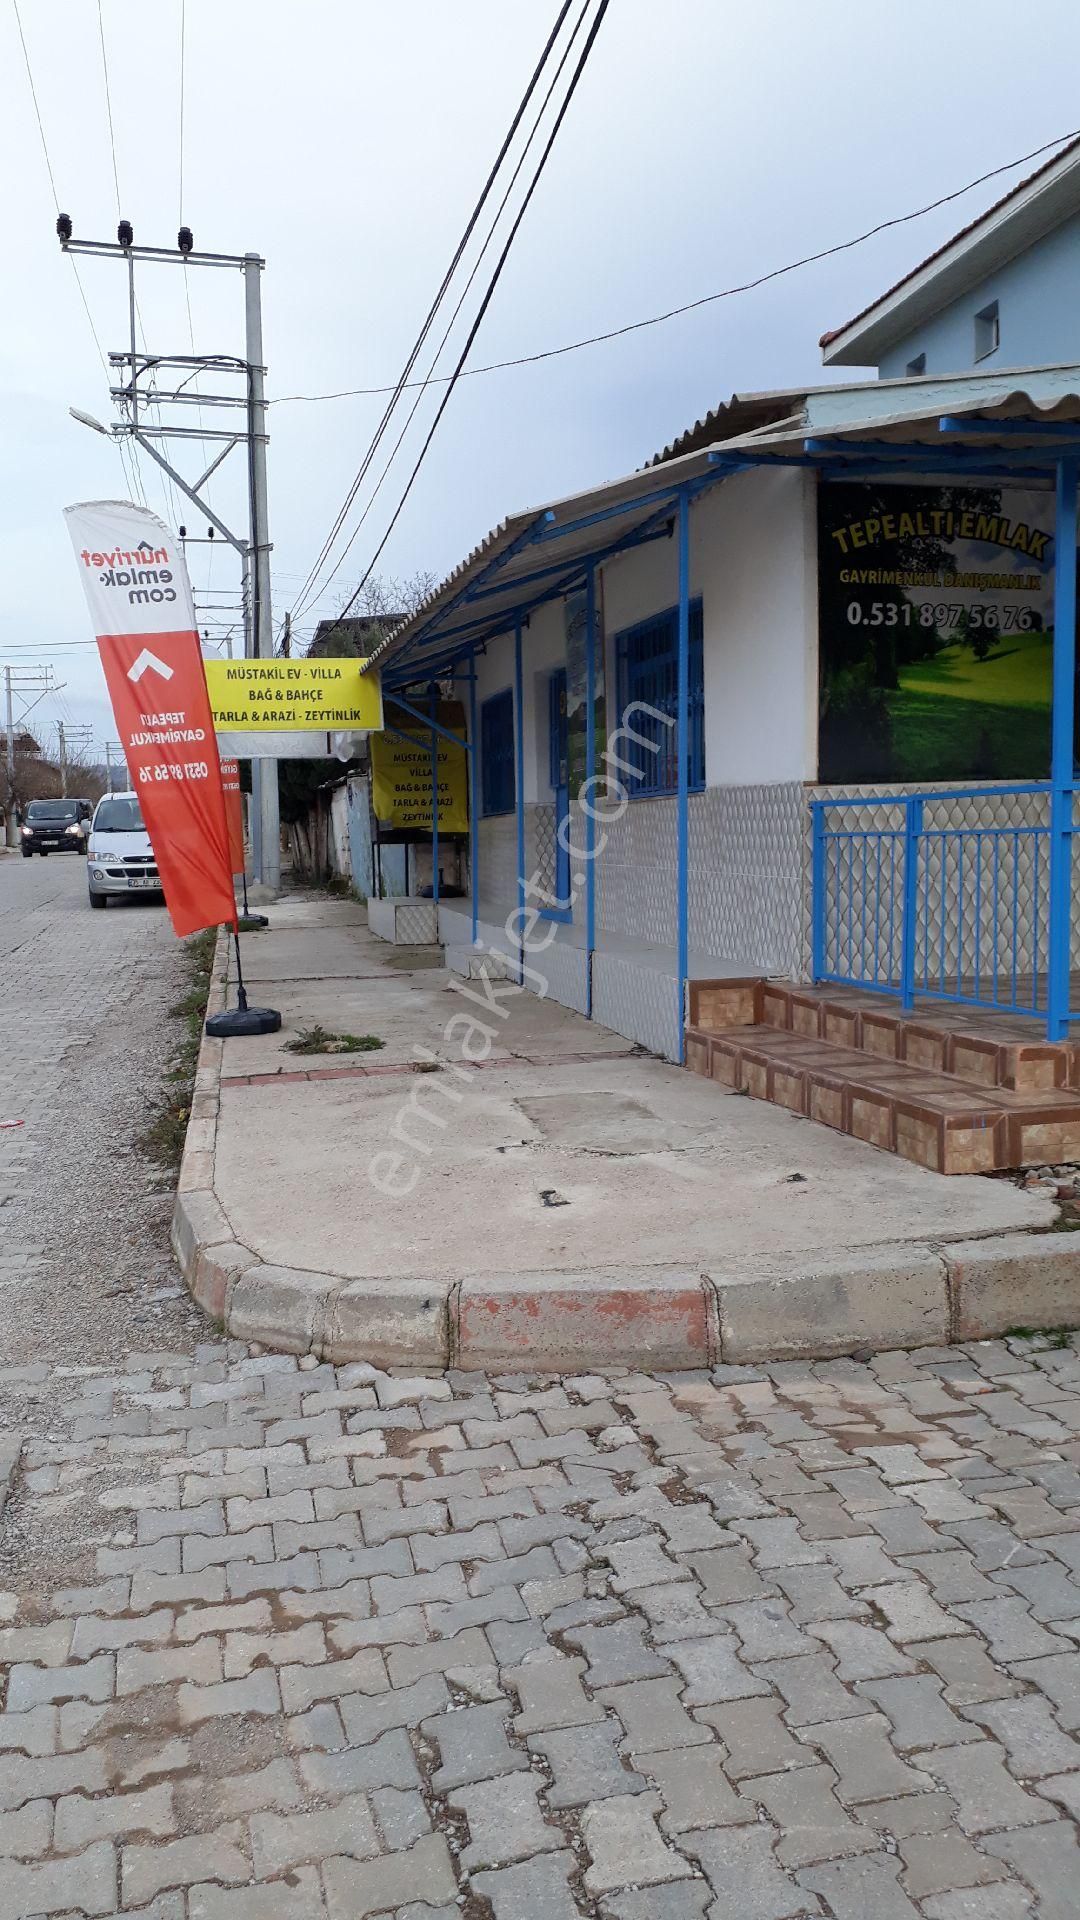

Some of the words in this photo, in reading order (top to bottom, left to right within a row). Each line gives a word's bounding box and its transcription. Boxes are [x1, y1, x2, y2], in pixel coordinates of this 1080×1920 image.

[831, 510, 954, 555] TEPEALTI
[959, 512, 1051, 561] EMLAK
[846, 601, 911, 627] 0.531
[919, 603, 964, 628] 897
[968, 604, 998, 628] 56
[1003, 605, 1033, 630] 76
[227, 668, 285, 680] MÜSTAKİL
[287, 669, 302, 680] EV
[310, 668, 342, 680] VİLLA
[249, 687, 273, 701] BAĞ
[274, 690, 284, 701] &
[286, 690, 324, 702] BAHÇE
[212, 711, 249, 722] TARLA
[251, 711, 261, 721] &
[262, 709, 296, 721] ARAZİ
[304, 708, 361, 721] ZEYTİNLİK
[437, 753, 448, 762] EV
[409, 768, 433, 777] VİLLA
[395, 782, 413, 792] BAĞ
[414, 783, 421, 791] &
[422, 783, 449, 793] BAÇE
[393, 799, 420, 807] TARLA
[420, 798, 428, 806] &
[429, 797, 453, 806] AAZİ
